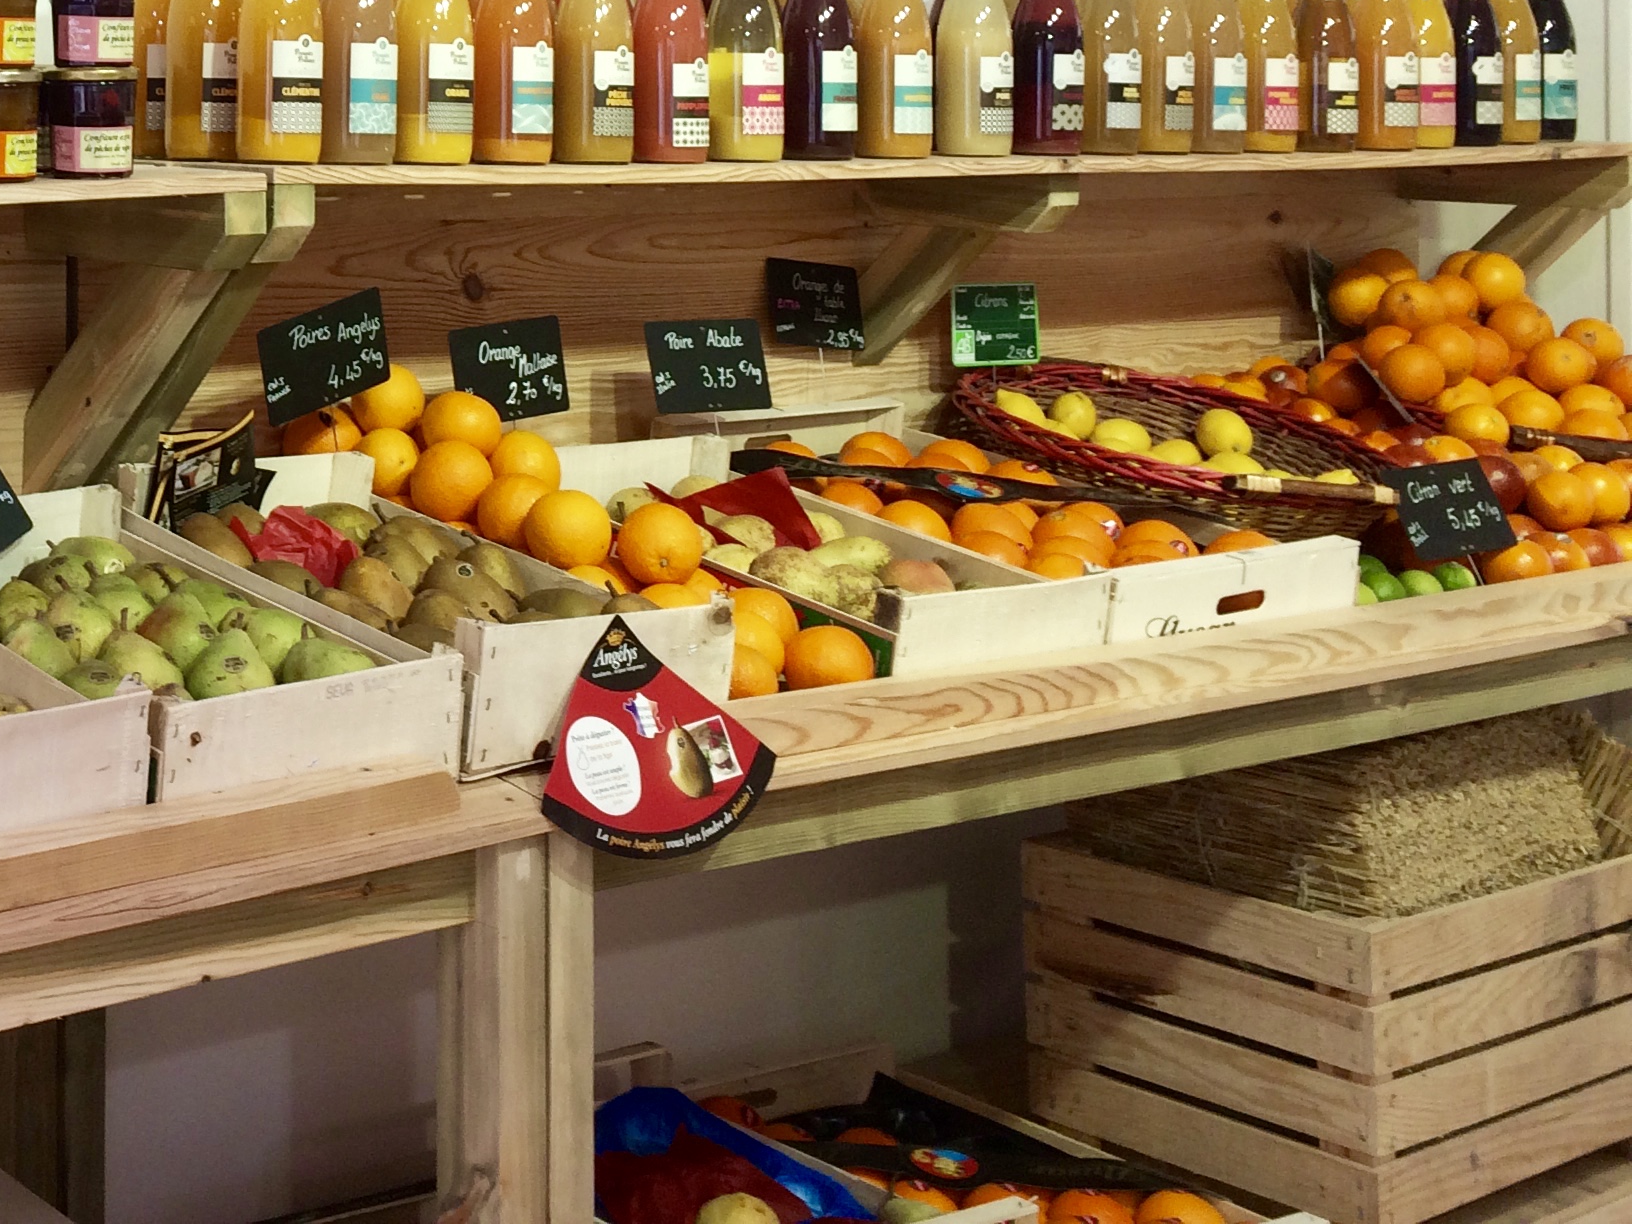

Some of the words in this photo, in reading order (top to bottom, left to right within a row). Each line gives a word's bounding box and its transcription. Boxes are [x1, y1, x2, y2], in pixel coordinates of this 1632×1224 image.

[288, 325, 331, 350] Poires
[664, 331, 694, 350] Poire
[706, 326, 744, 348] Abate
[478, 341, 521, 369] Orange
[1408, 480, 1442, 504] Citron
[596, 827, 609, 842] La
